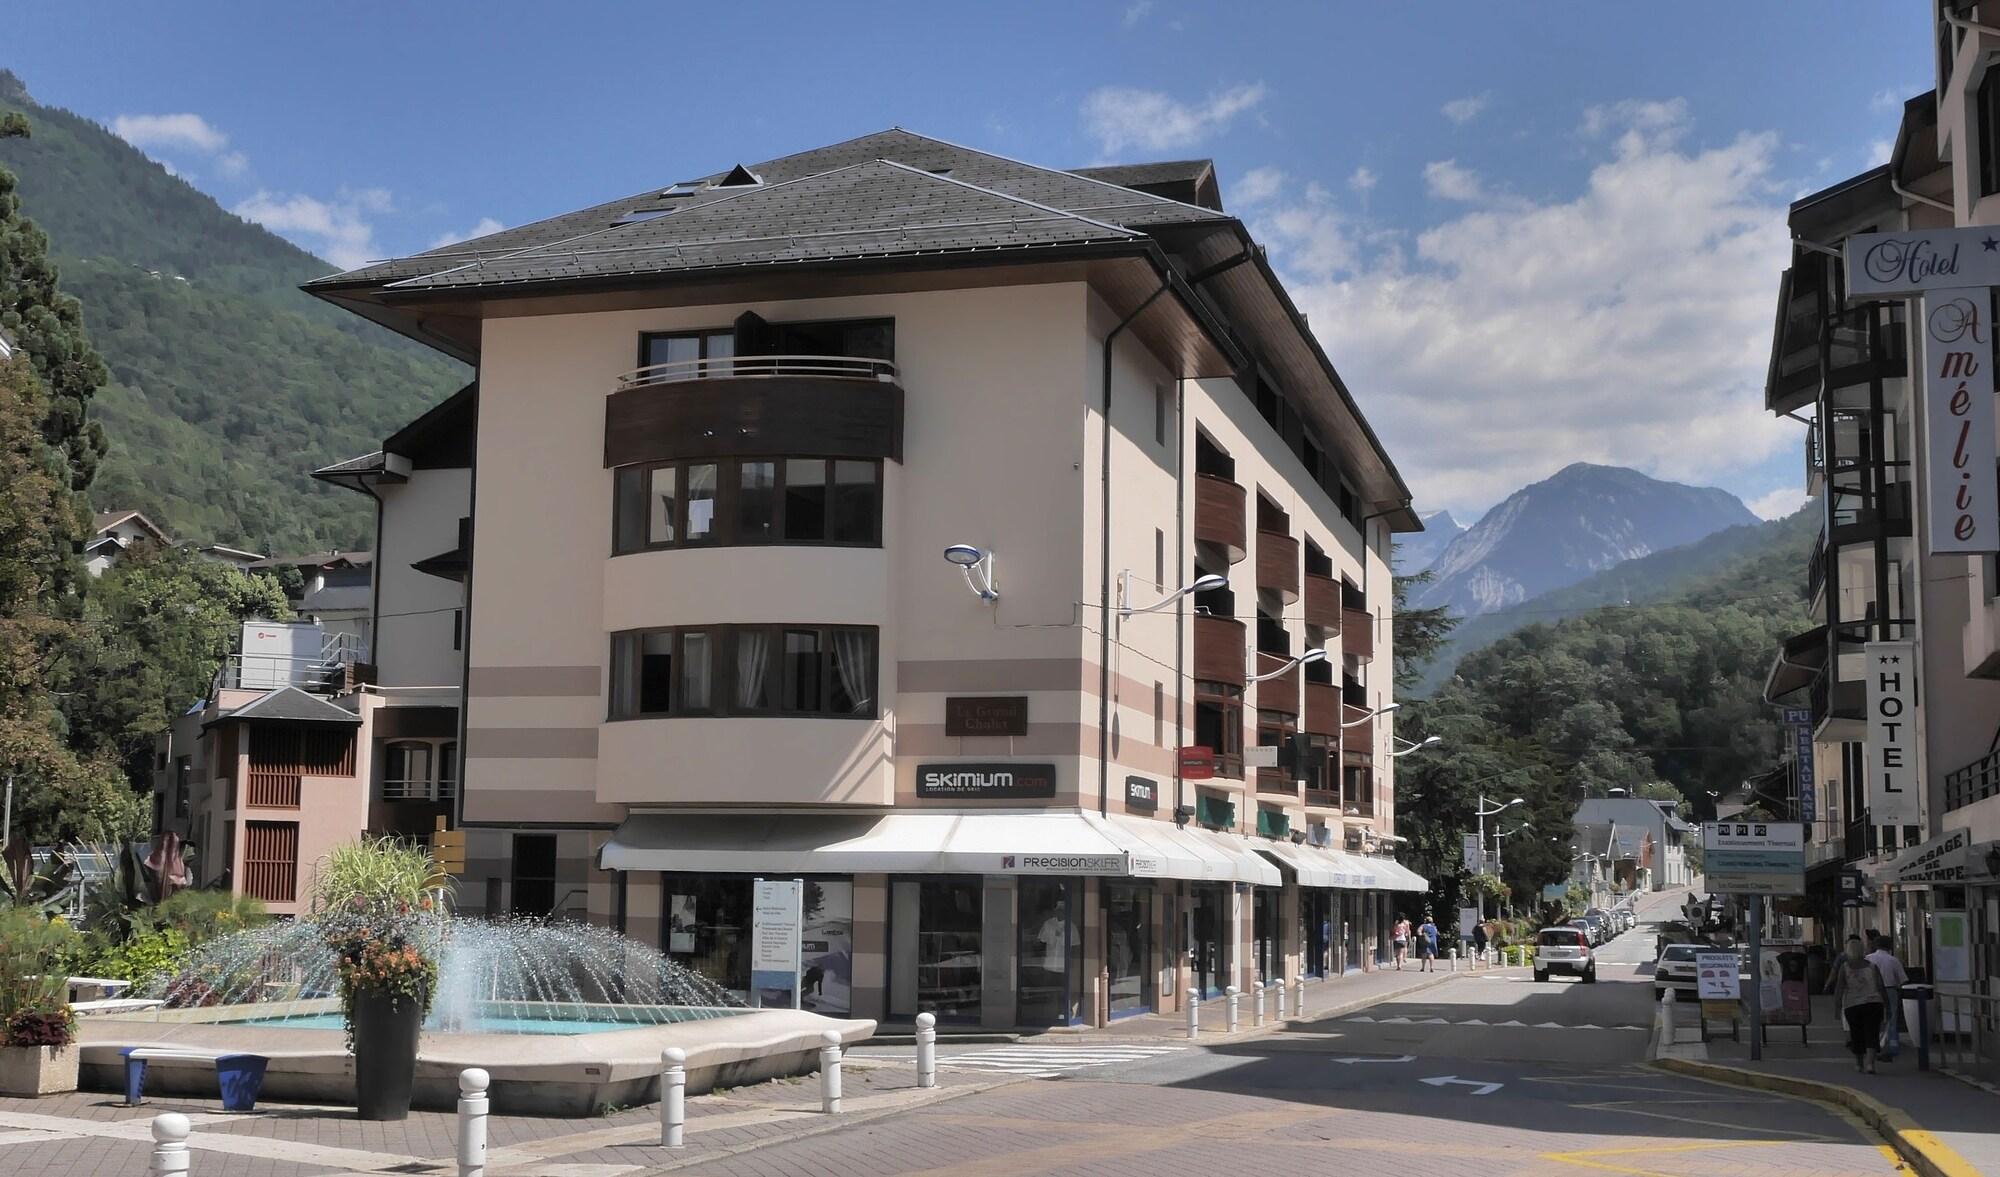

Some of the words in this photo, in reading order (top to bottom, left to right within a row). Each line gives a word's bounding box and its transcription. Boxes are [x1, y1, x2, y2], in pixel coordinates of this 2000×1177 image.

[1864, 239, 1960, 283] Hotel
[1929, 298, 1988, 541] Amélie
[1799, 727, 1814, 819] RESTAURANT
[1880, 672, 1903, 793] HOTEL
